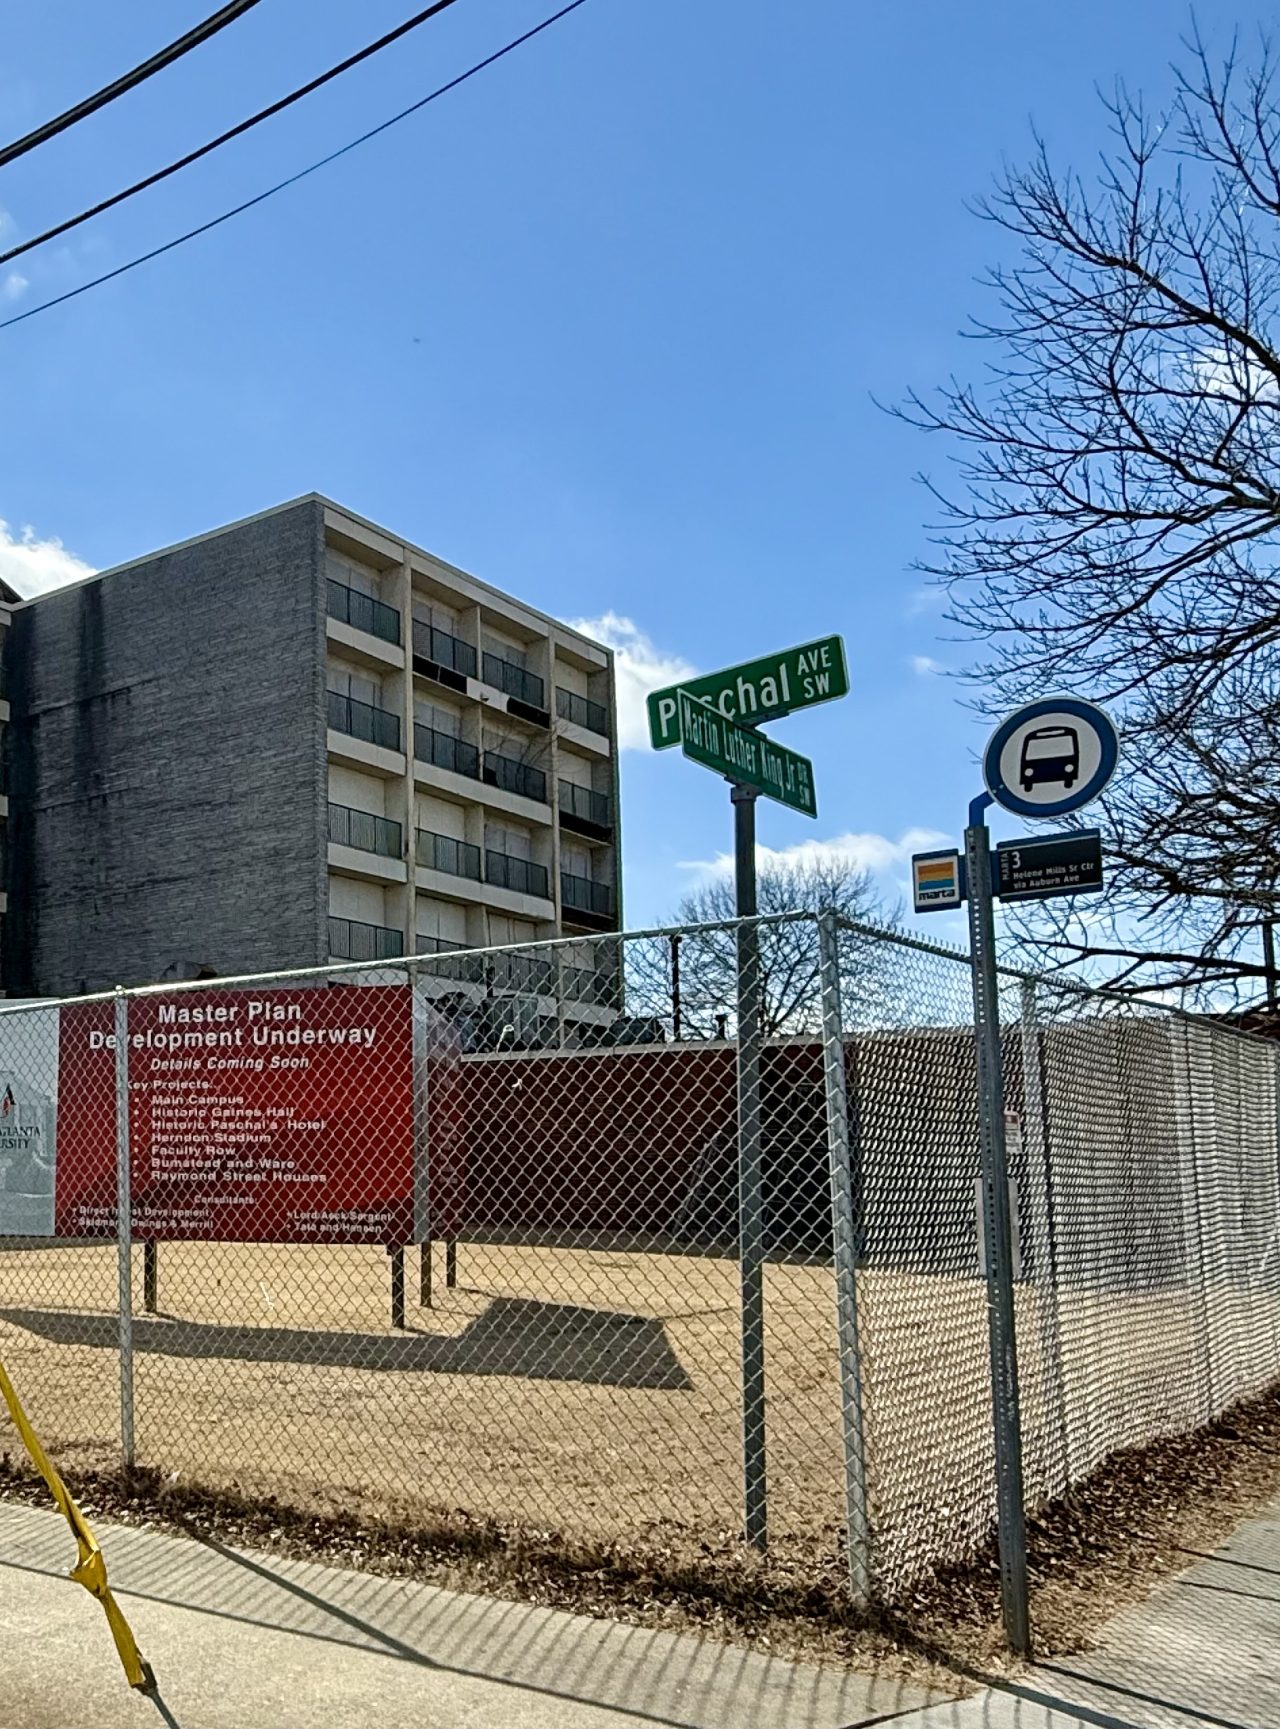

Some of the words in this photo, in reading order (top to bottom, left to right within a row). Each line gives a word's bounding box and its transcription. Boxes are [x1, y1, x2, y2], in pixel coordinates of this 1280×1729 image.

[658, 663, 790, 737] Pchal
[797, 646, 832, 676] AVE
[804, 673, 830, 699] SW
[683, 697, 720, 755] Martin
[722, 722, 756, 774] Luther
[760, 741, 784, 798] King
[785, 753, 795, 792] Jr
[797, 761, 808, 784] DR
[799, 784, 811, 806] SW
[1001, 852, 1009, 881] MARTA
[1011, 851, 1021, 869] 3
[1013, 869, 1043, 880] Helene
[1046, 866, 1066, 875] Mills
[1068, 864, 1078, 873] Sr
[1081, 861, 1095, 871] Ctr
[1013, 880, 1026, 889] via
[1029, 878, 1061, 887] Auburn
[1063, 874, 1080, 883] Ave
[919, 889, 956, 900] marta
[158, 1004, 238, 1023] Master
[248, 1002, 301, 1021] Plan
[89, 1028, 243, 1050] Deelopment
[253, 1025, 377, 1048] Underway
[150, 1057, 201, 1071] Details
[207, 1056, 265, 1071] Coming
[270, 1055, 310, 1068] Soon
[152, 1095, 184, 1105] Main
[188, 1095, 244, 1106] Campus
[152, 1107, 206, 1118] Historic
[212, 1107, 262, 1118] Gaines
[267, 1107, 295, 1118] Hall
[151, 1120, 205, 1130] Historic
[211, 1120, 278, 1130] Paschal's
[287, 1120, 325, 1130] Hotel
[152, 1132, 210, 1143] Herndon
[214, 1132, 271, 1143] Stadium
[152, 1145, 202, 1157] Faculty
[206, 1145, 236, 1155] Row
[151, 1158, 219, 1168] Bumstead
[226, 1158, 253, 1168] and
[259, 1158, 296, 1169] Ware
[151, 1171, 216, 1183] Raymond
[223, 1171, 267, 1181] Street
[272, 1172, 327, 1182] Houses
[79, 1217, 120, 1227] Skidmor
